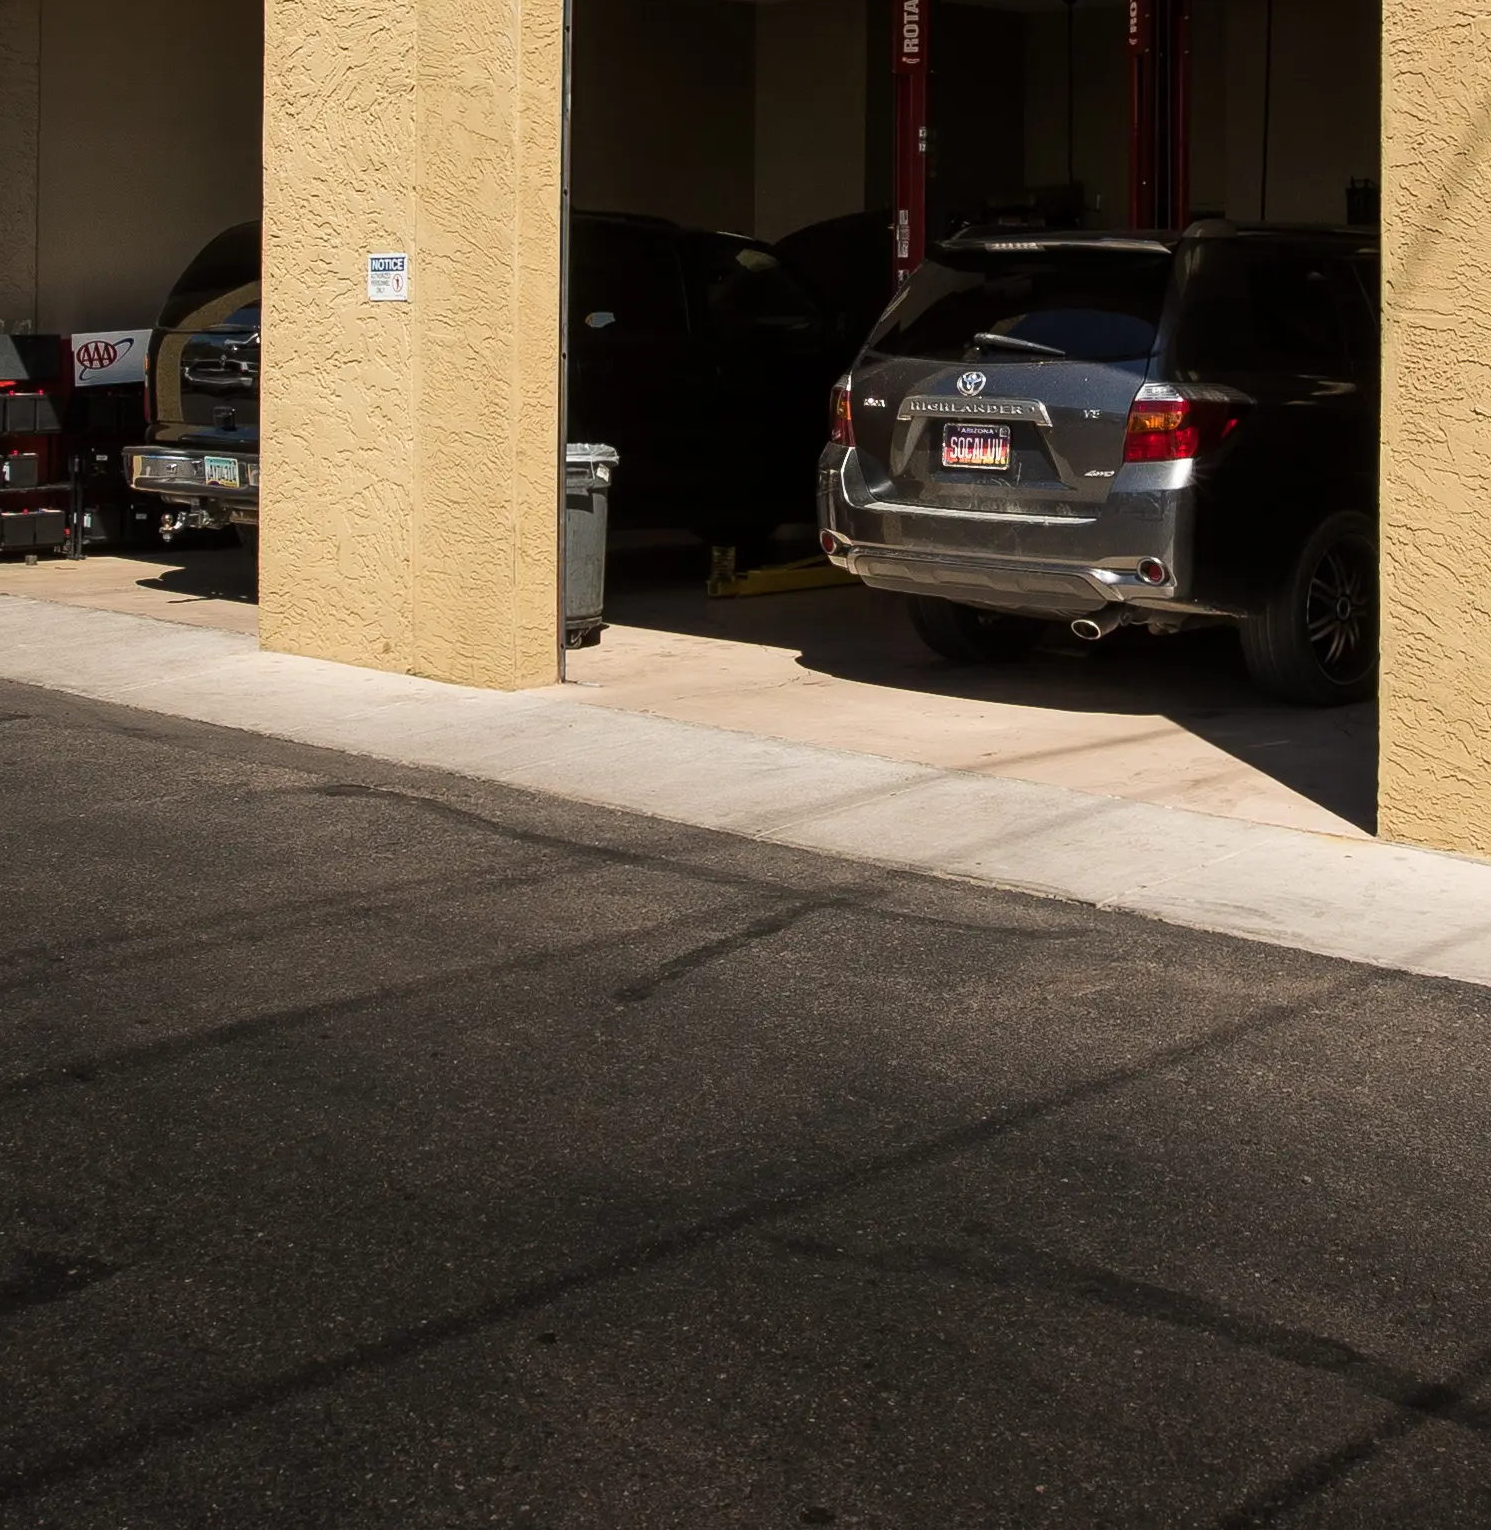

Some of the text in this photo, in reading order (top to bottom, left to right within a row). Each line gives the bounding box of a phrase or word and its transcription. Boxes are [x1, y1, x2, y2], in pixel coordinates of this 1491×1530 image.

[372, 258, 404, 271] NOTICE
[77, 341, 117, 370] AAA
[910, 401, 1023, 415] HIGHLANDER
[961, 427, 994, 435] ARIZONA
[950, 437, 1003, 461] SOCALUV
